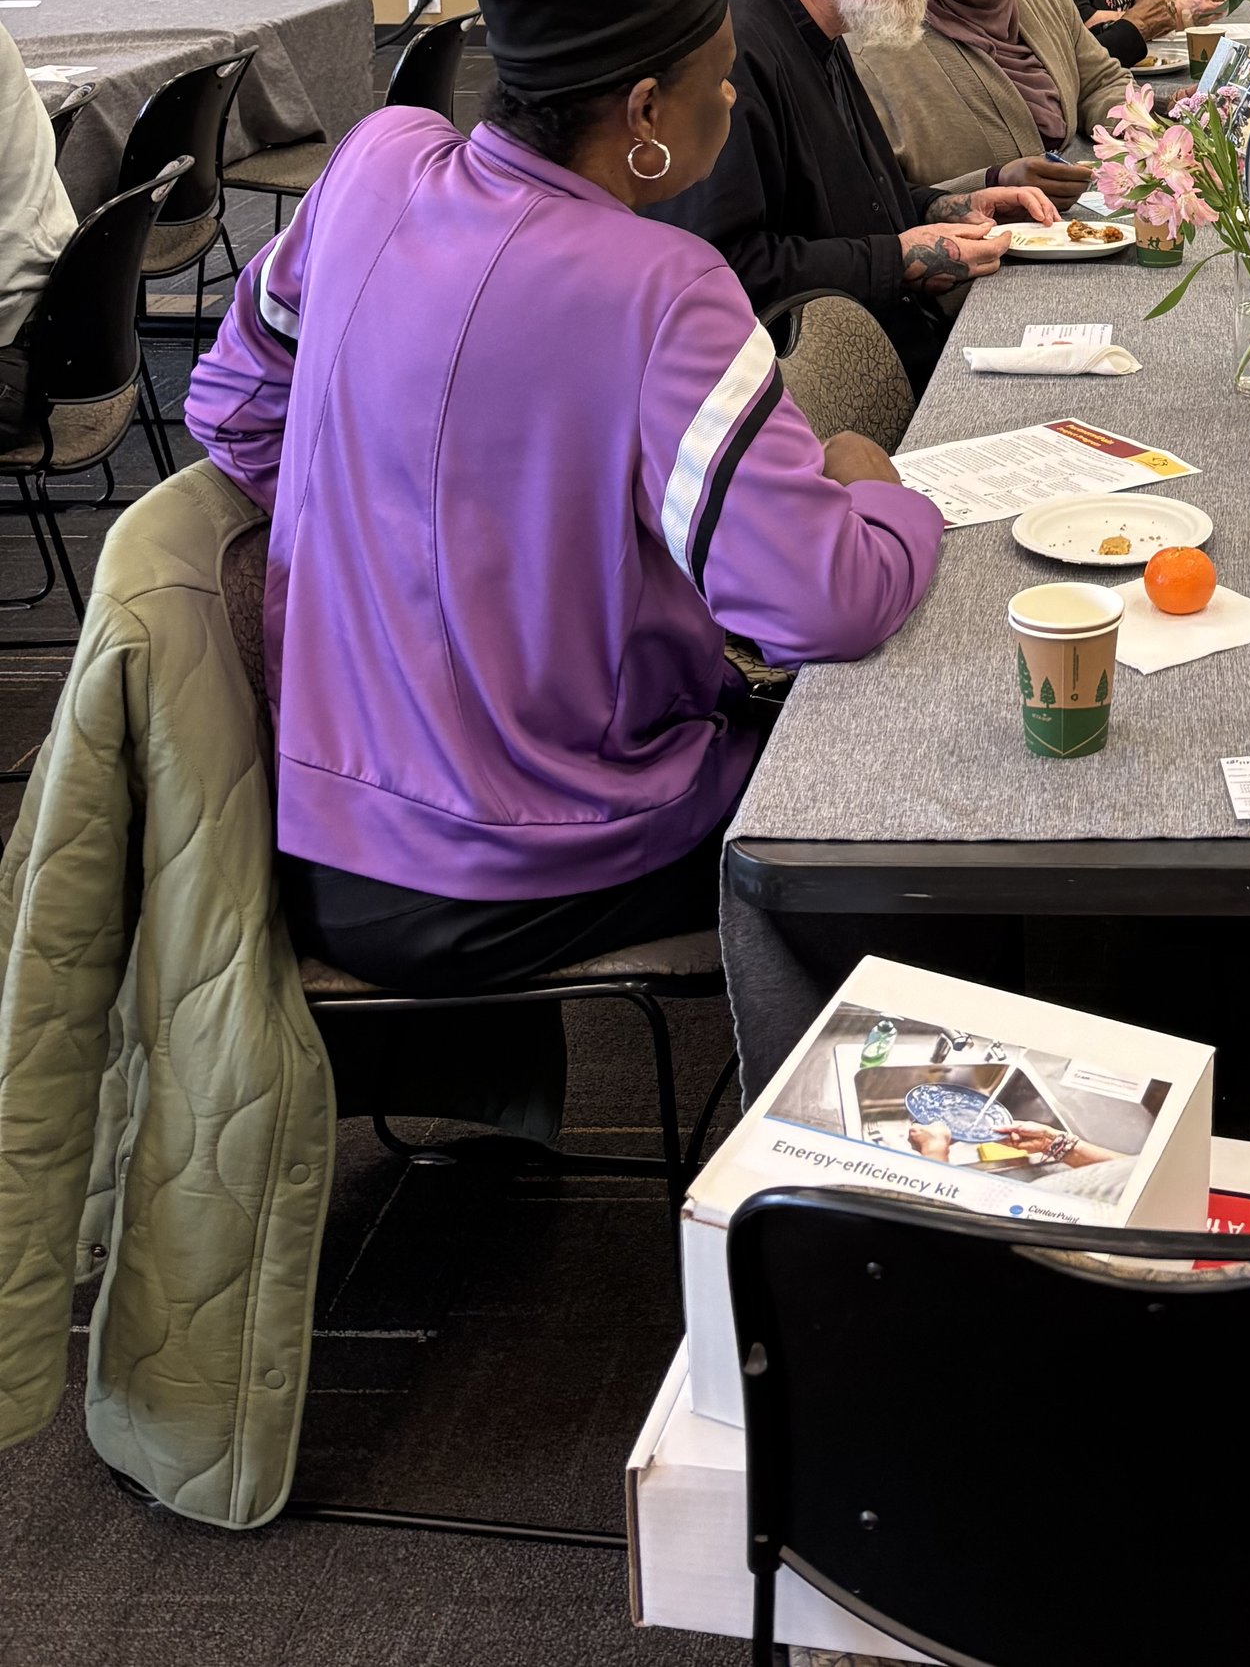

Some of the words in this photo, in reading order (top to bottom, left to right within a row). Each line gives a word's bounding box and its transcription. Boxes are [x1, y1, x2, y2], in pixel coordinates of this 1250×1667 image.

[771, 1139, 931, 1193] Energy-efficiency
[933, 1181, 961, 1200] kit
[1028, 1204, 1080, 1225] CenterPoint
